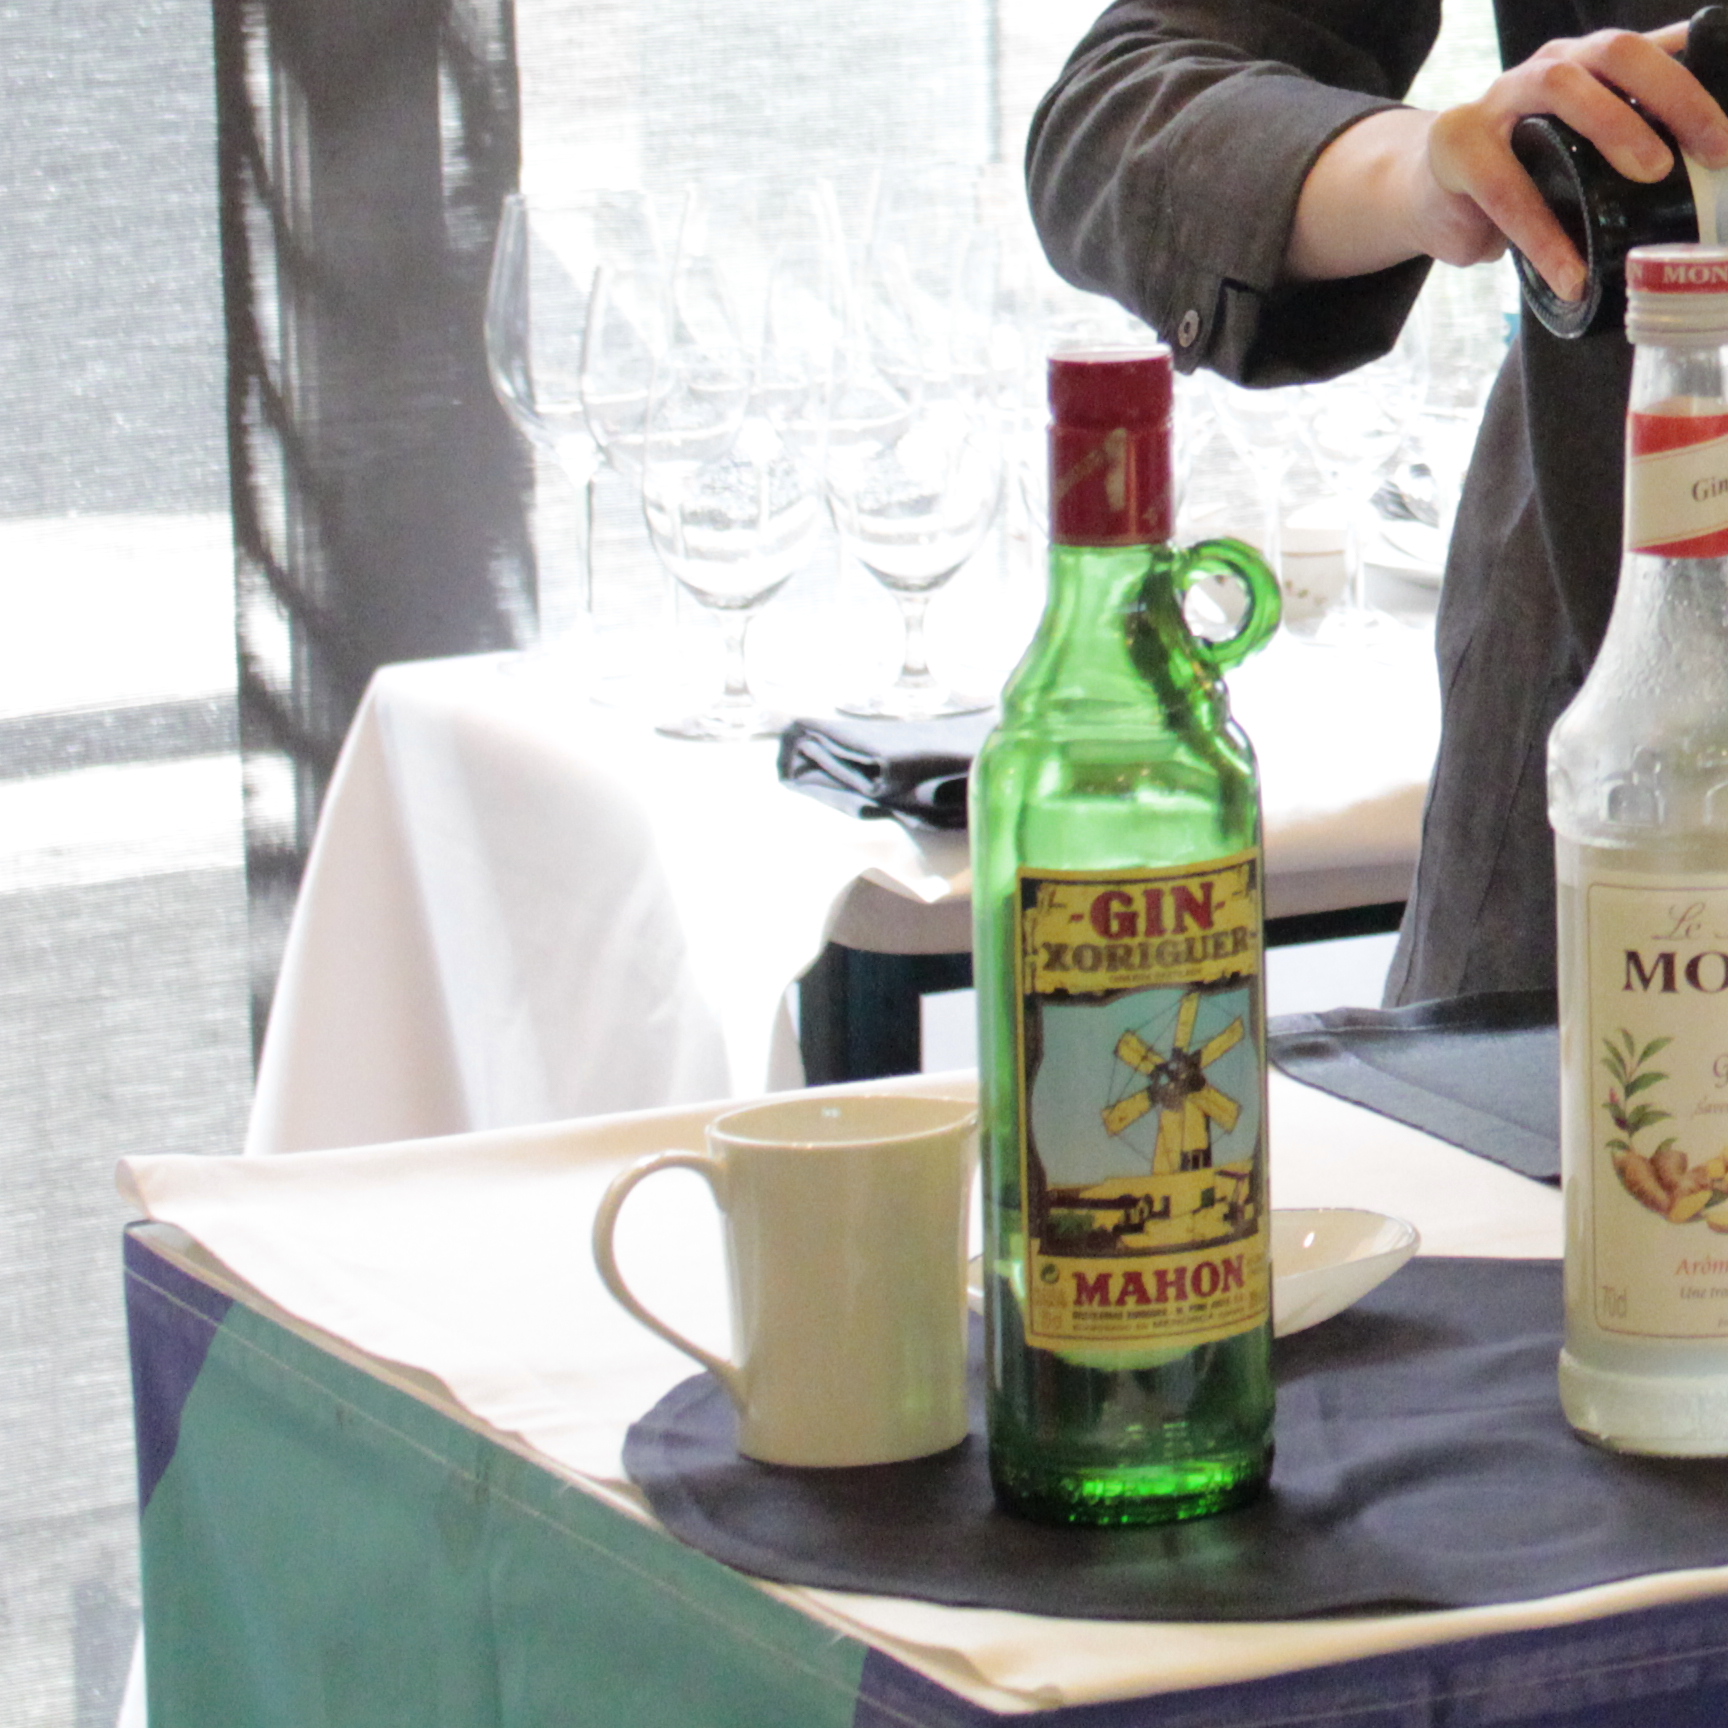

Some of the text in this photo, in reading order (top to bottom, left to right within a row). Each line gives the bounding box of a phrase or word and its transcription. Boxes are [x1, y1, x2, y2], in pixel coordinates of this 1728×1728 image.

[1088, 881, 1216, 940] GIN
[1650, 901, 1706, 942] Le
[1041, 925, 1249, 972] XORIGUER
[1071, 1252, 1246, 1308] MAHON
[1679, 1284, 1708, 1300] Une
